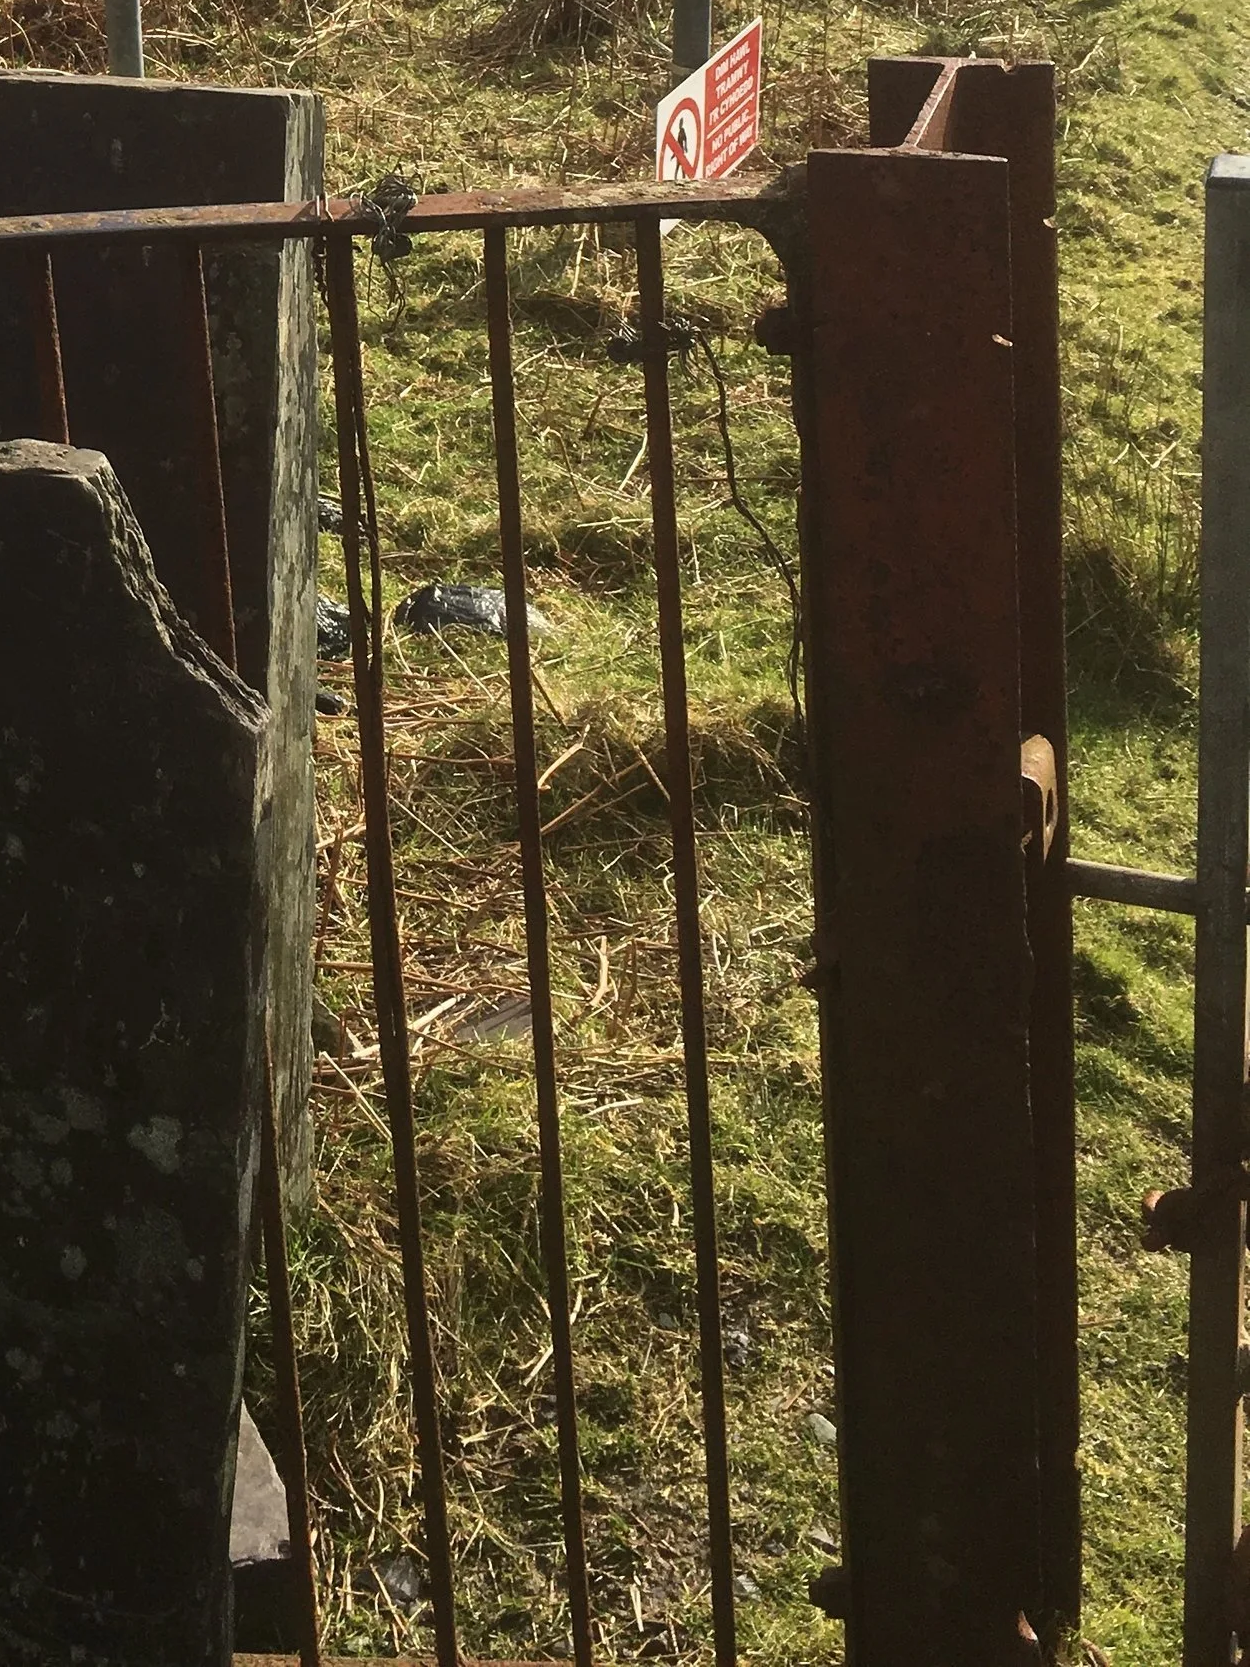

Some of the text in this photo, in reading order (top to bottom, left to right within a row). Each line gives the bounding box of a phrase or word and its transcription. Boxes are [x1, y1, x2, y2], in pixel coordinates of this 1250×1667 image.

[712, 108, 750, 154] NO PUBLIC
[728, 137, 738, 156] OF
